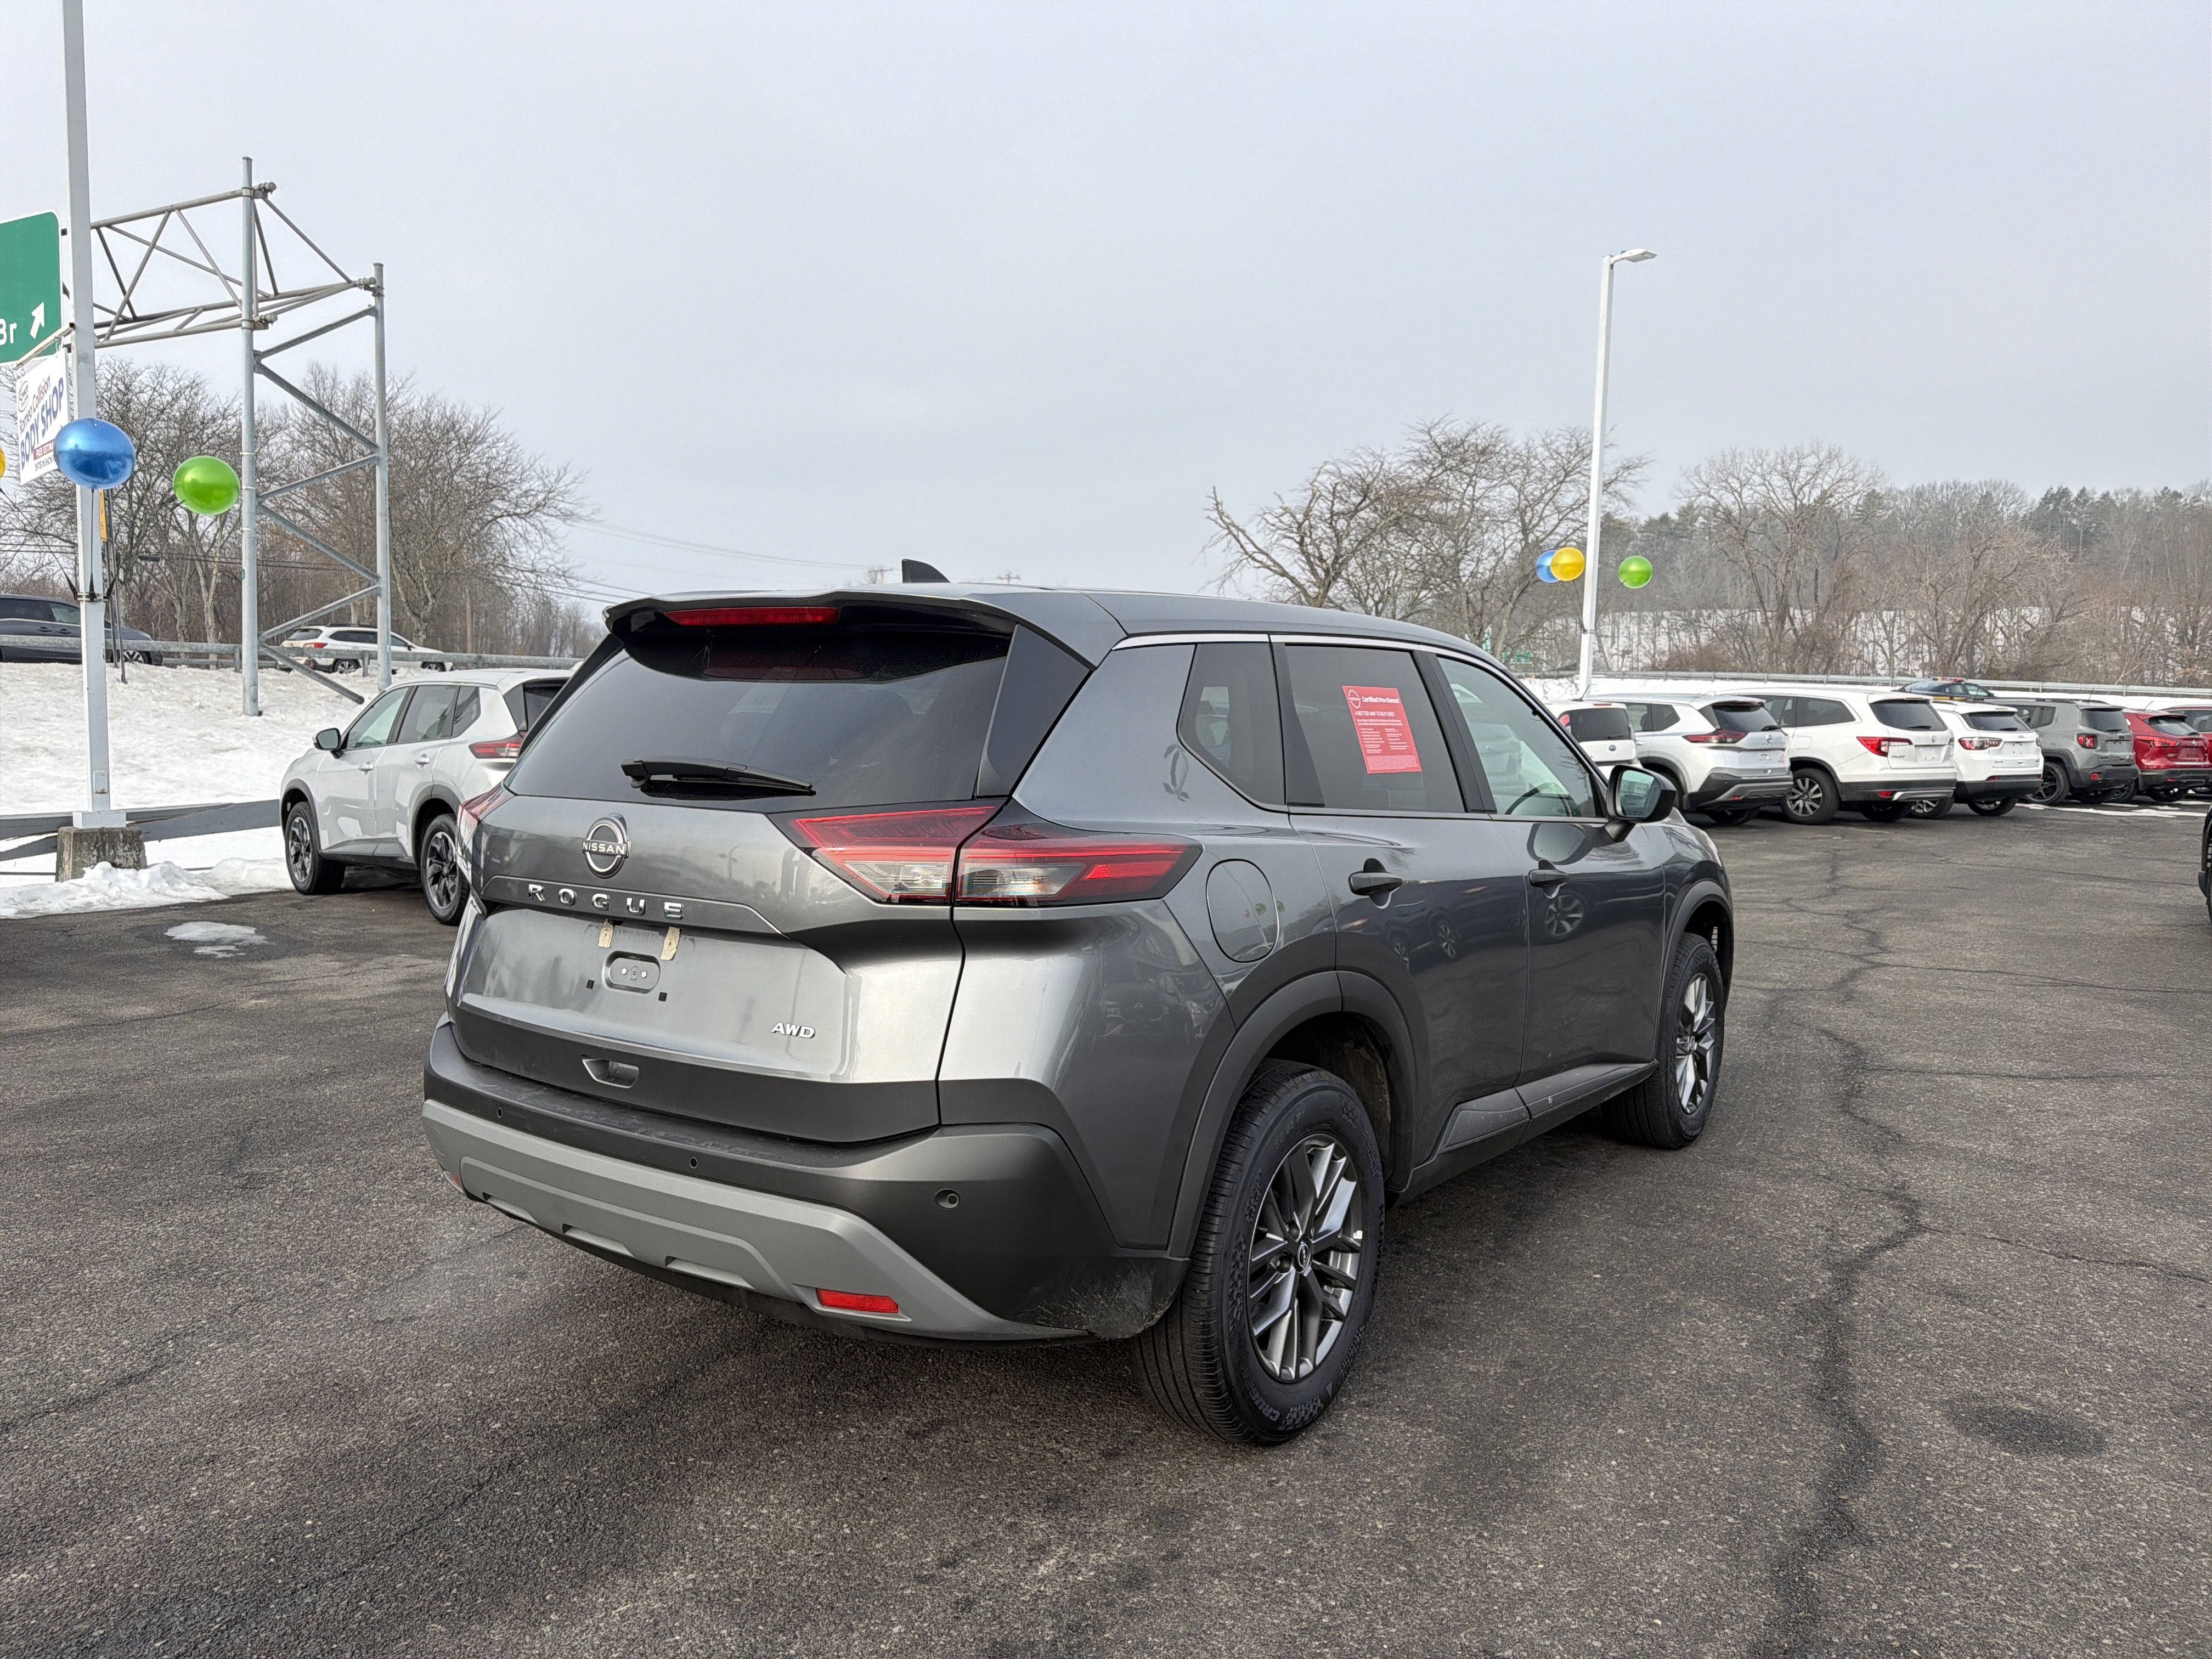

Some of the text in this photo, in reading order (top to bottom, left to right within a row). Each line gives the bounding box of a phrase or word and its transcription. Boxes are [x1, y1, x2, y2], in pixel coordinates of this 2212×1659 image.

[32, 375, 50, 411] Collision
[21, 413, 40, 470] BODY
[41, 377, 64, 438] SHOP
[583, 842, 625, 855] NISSAN
[528, 884, 684, 919] ROGUE
[771, 1022, 815, 1039] AWD
